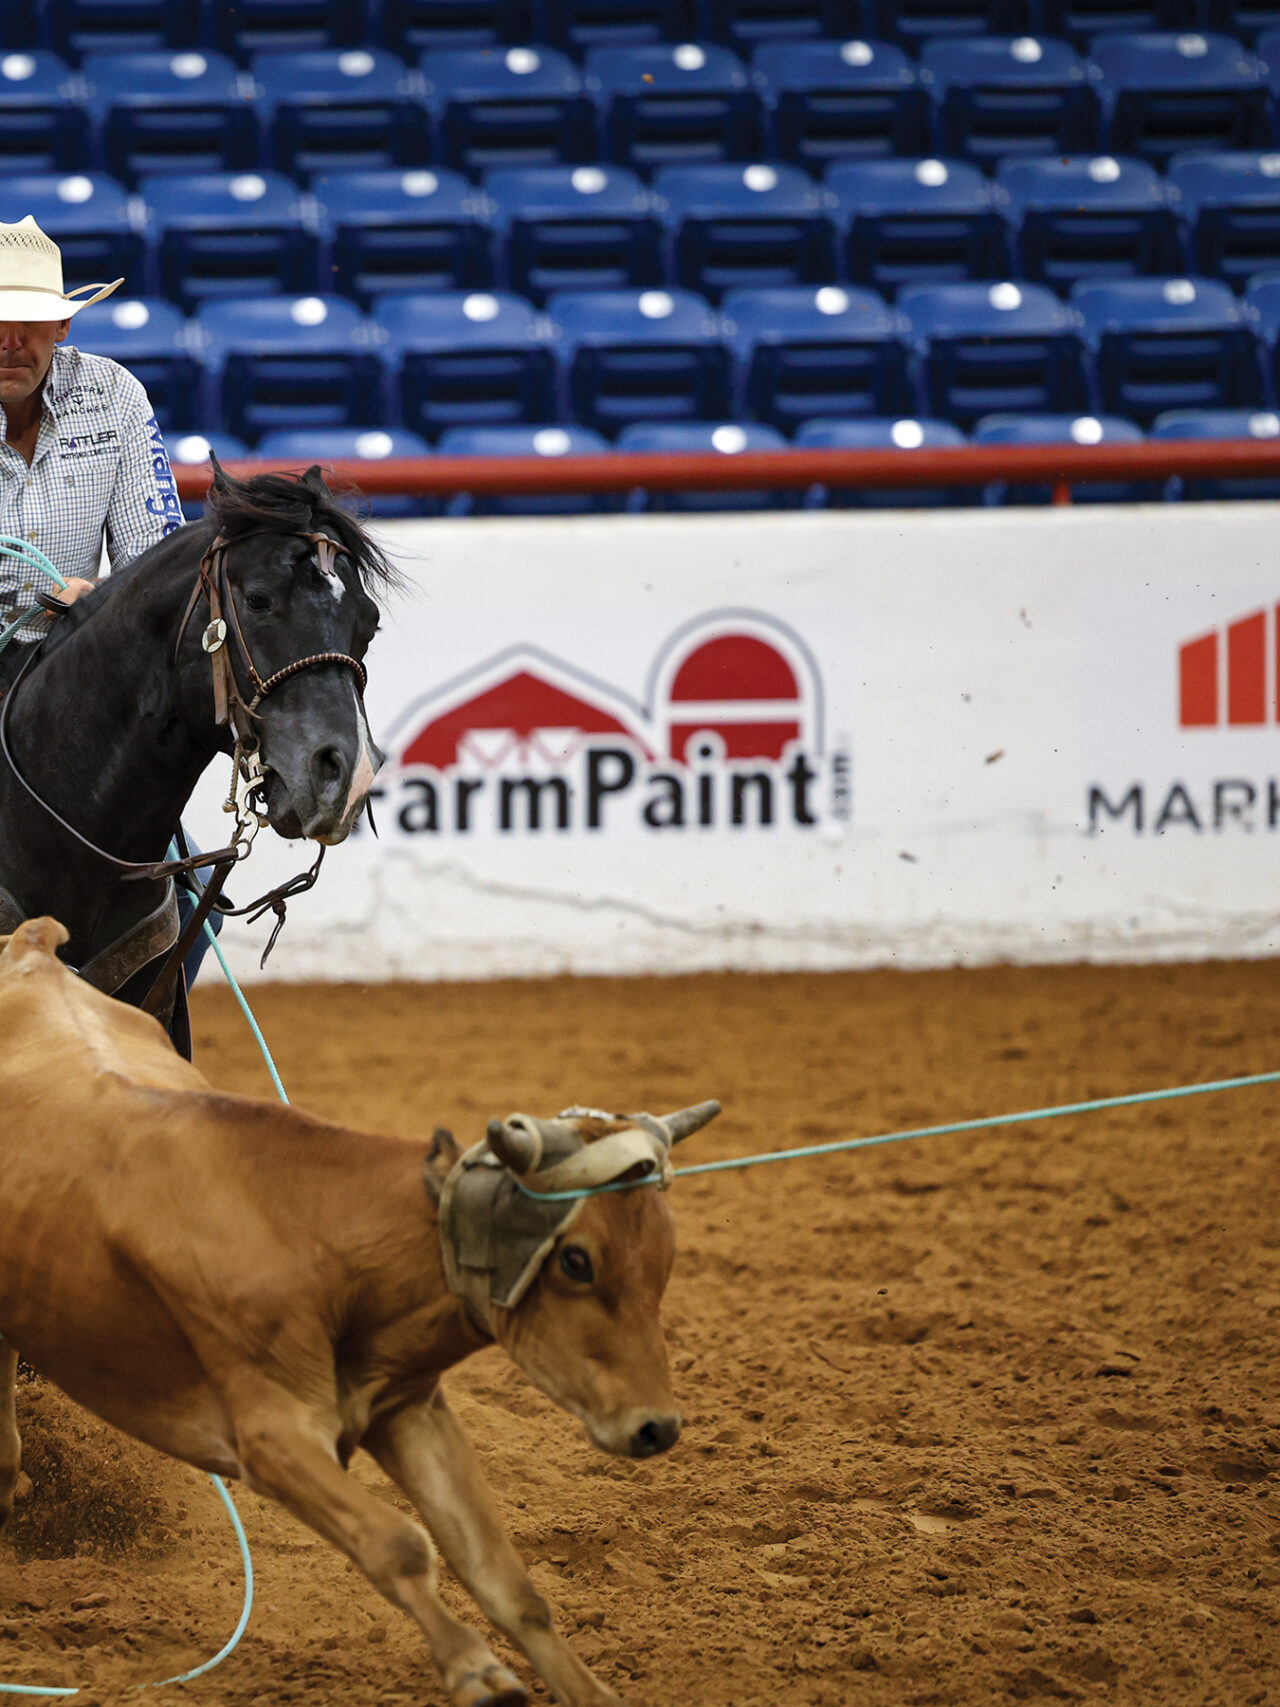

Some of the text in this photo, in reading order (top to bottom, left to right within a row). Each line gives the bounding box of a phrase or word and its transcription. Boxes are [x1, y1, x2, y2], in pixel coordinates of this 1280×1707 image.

[56, 404, 108, 420] RANCHES
[59, 430, 119, 449] RATTLER
[146, 416, 181, 537] Wrangle
[1087, 775, 1280, 835] MAR
